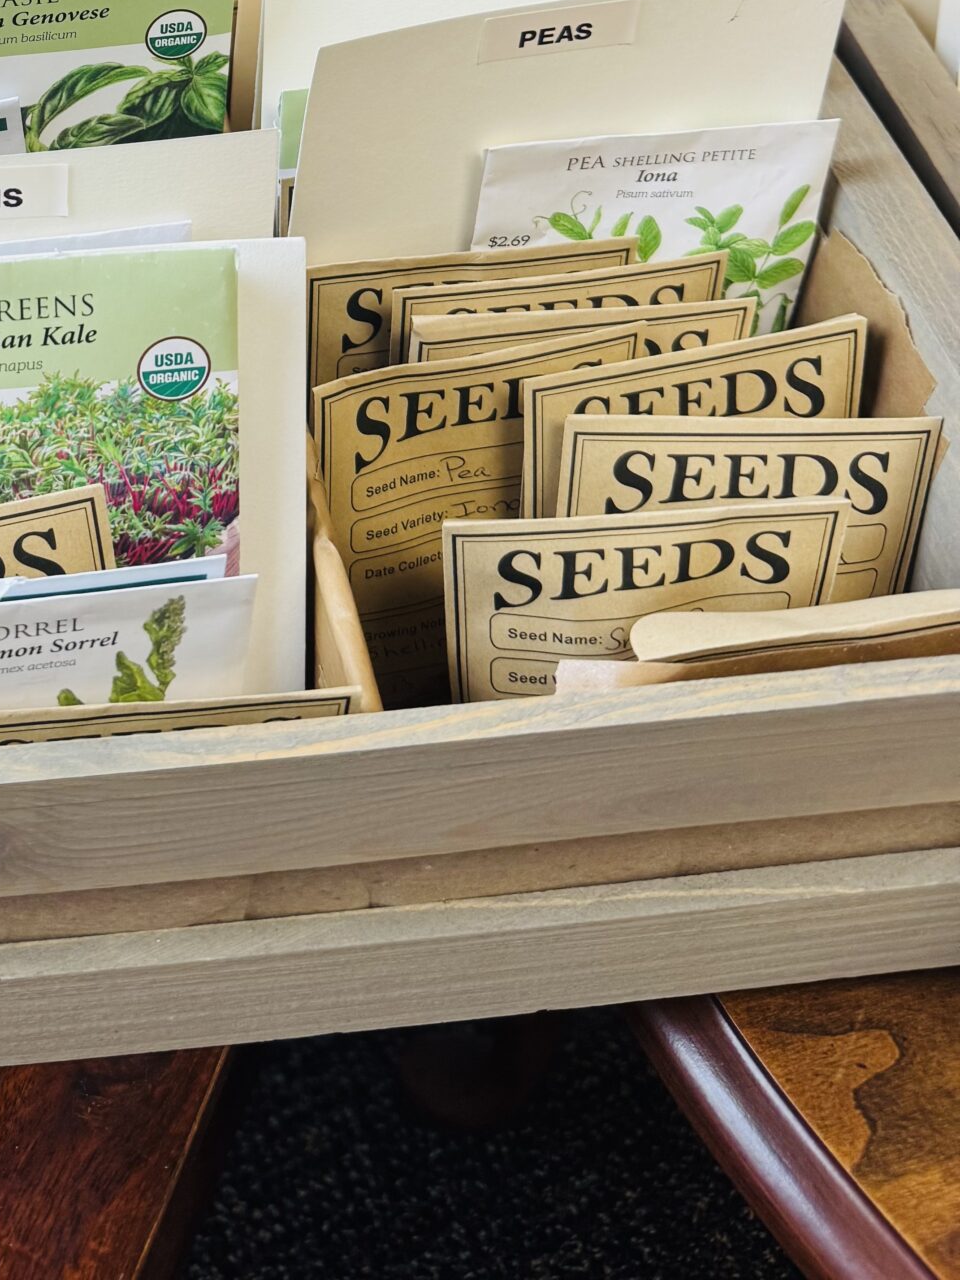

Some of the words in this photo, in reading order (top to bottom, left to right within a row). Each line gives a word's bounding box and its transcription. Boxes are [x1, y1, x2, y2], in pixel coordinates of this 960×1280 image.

[12, 7, 110, 27] Genovese
[21, 29, 77, 43] basilicum
[160, 21, 193, 35] USDA
[519, 22, 593, 49] PEAS
[154, 34, 197, 48] ORGANIC
[567, 155, 605, 171] PEA
[613, 151, 696, 168] SHELLING
[702, 148, 757, 162] PETITE
[635, 170, 678, 183] Iona
[616, 189, 648, 199] Pisum
[650, 189, 693, 199] sativum
[488, 234, 530, 248] $2.69
[41, 323, 98, 346] Kale
[0, 359, 43, 376] napus
[154, 352, 195, 368] USDA
[148, 369, 200, 386] ORGANIC
[441, 455, 491, 483] Pea
[366, 478, 397, 498] Seed
[399, 468, 440, 487] Name:
[605, 449, 890, 515] SEEDS
[366, 523, 398, 541] Seed
[402, 510, 449, 531] Variety:
[365, 565, 395, 580] Date
[493, 530, 792, 611] SEEDS
[49, 631, 119, 656] Sorrel
[507, 627, 548, 643] Seed
[552, 632, 603, 646] Name:
[28, 658, 77, 674] acetosa
[508, 671, 548, 685] Seed
